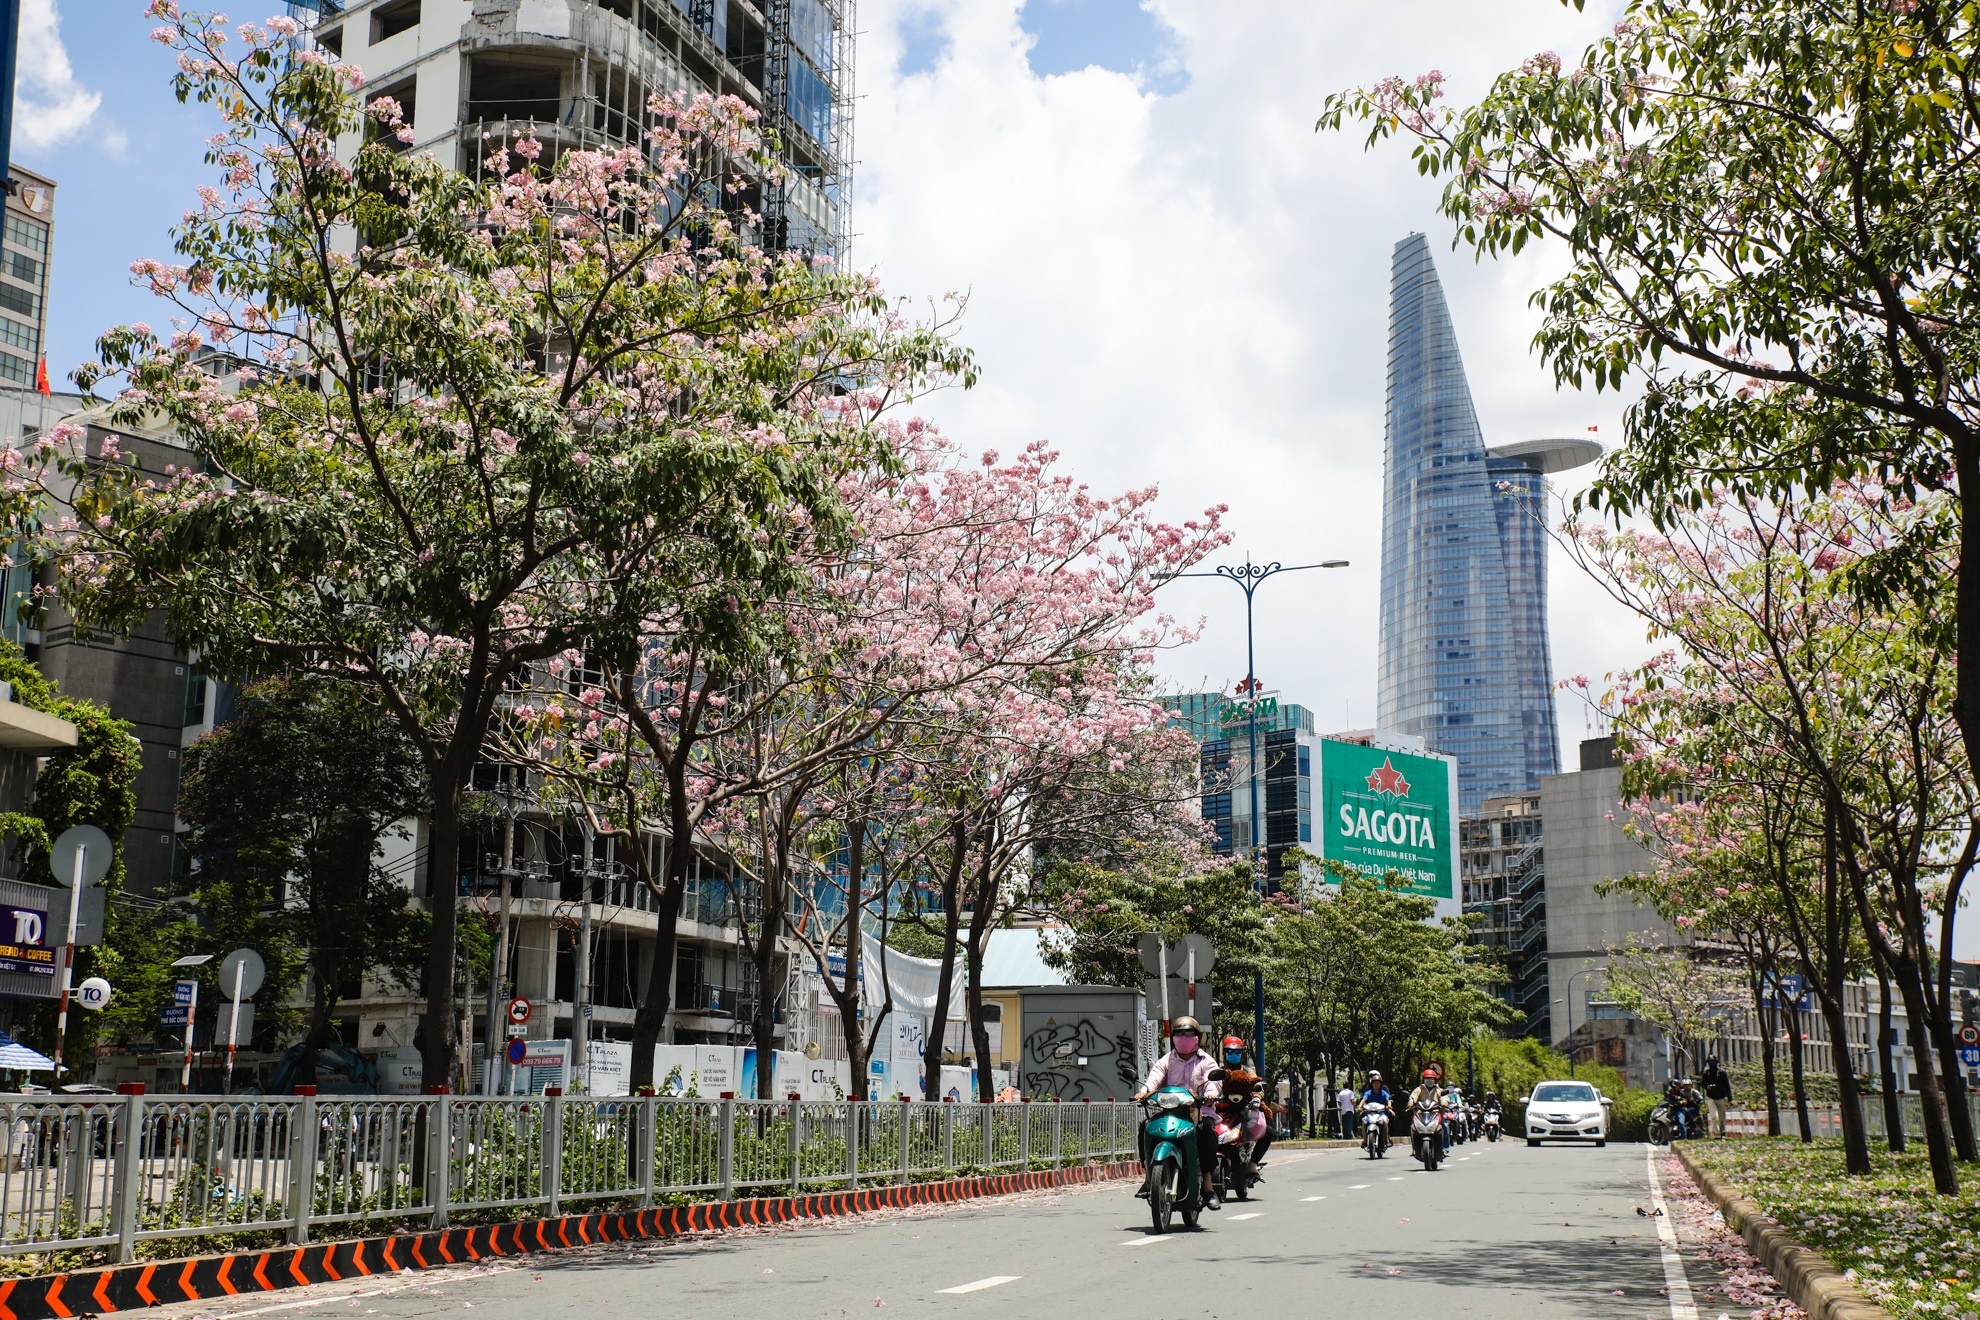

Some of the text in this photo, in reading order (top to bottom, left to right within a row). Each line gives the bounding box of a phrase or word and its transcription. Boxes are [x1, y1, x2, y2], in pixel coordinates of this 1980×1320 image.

[1340, 804, 1436, 849] SAGOTA
[1363, 847, 1417, 861] PREMIUM BEER
[1373, 863, 1384, 876] Du
[1418, 869, 1436, 882] Nam
[13, 911, 42, 945] TQ
[0, 945, 19, 957] READ
[27, 949, 53, 961] COFFEE
[83, 987, 102, 1002] TQ
[900, 1025, 918, 1041] 2017
[1964, 1031, 1975, 1040] 60
[1966, 1050, 1979, 1062] 30
